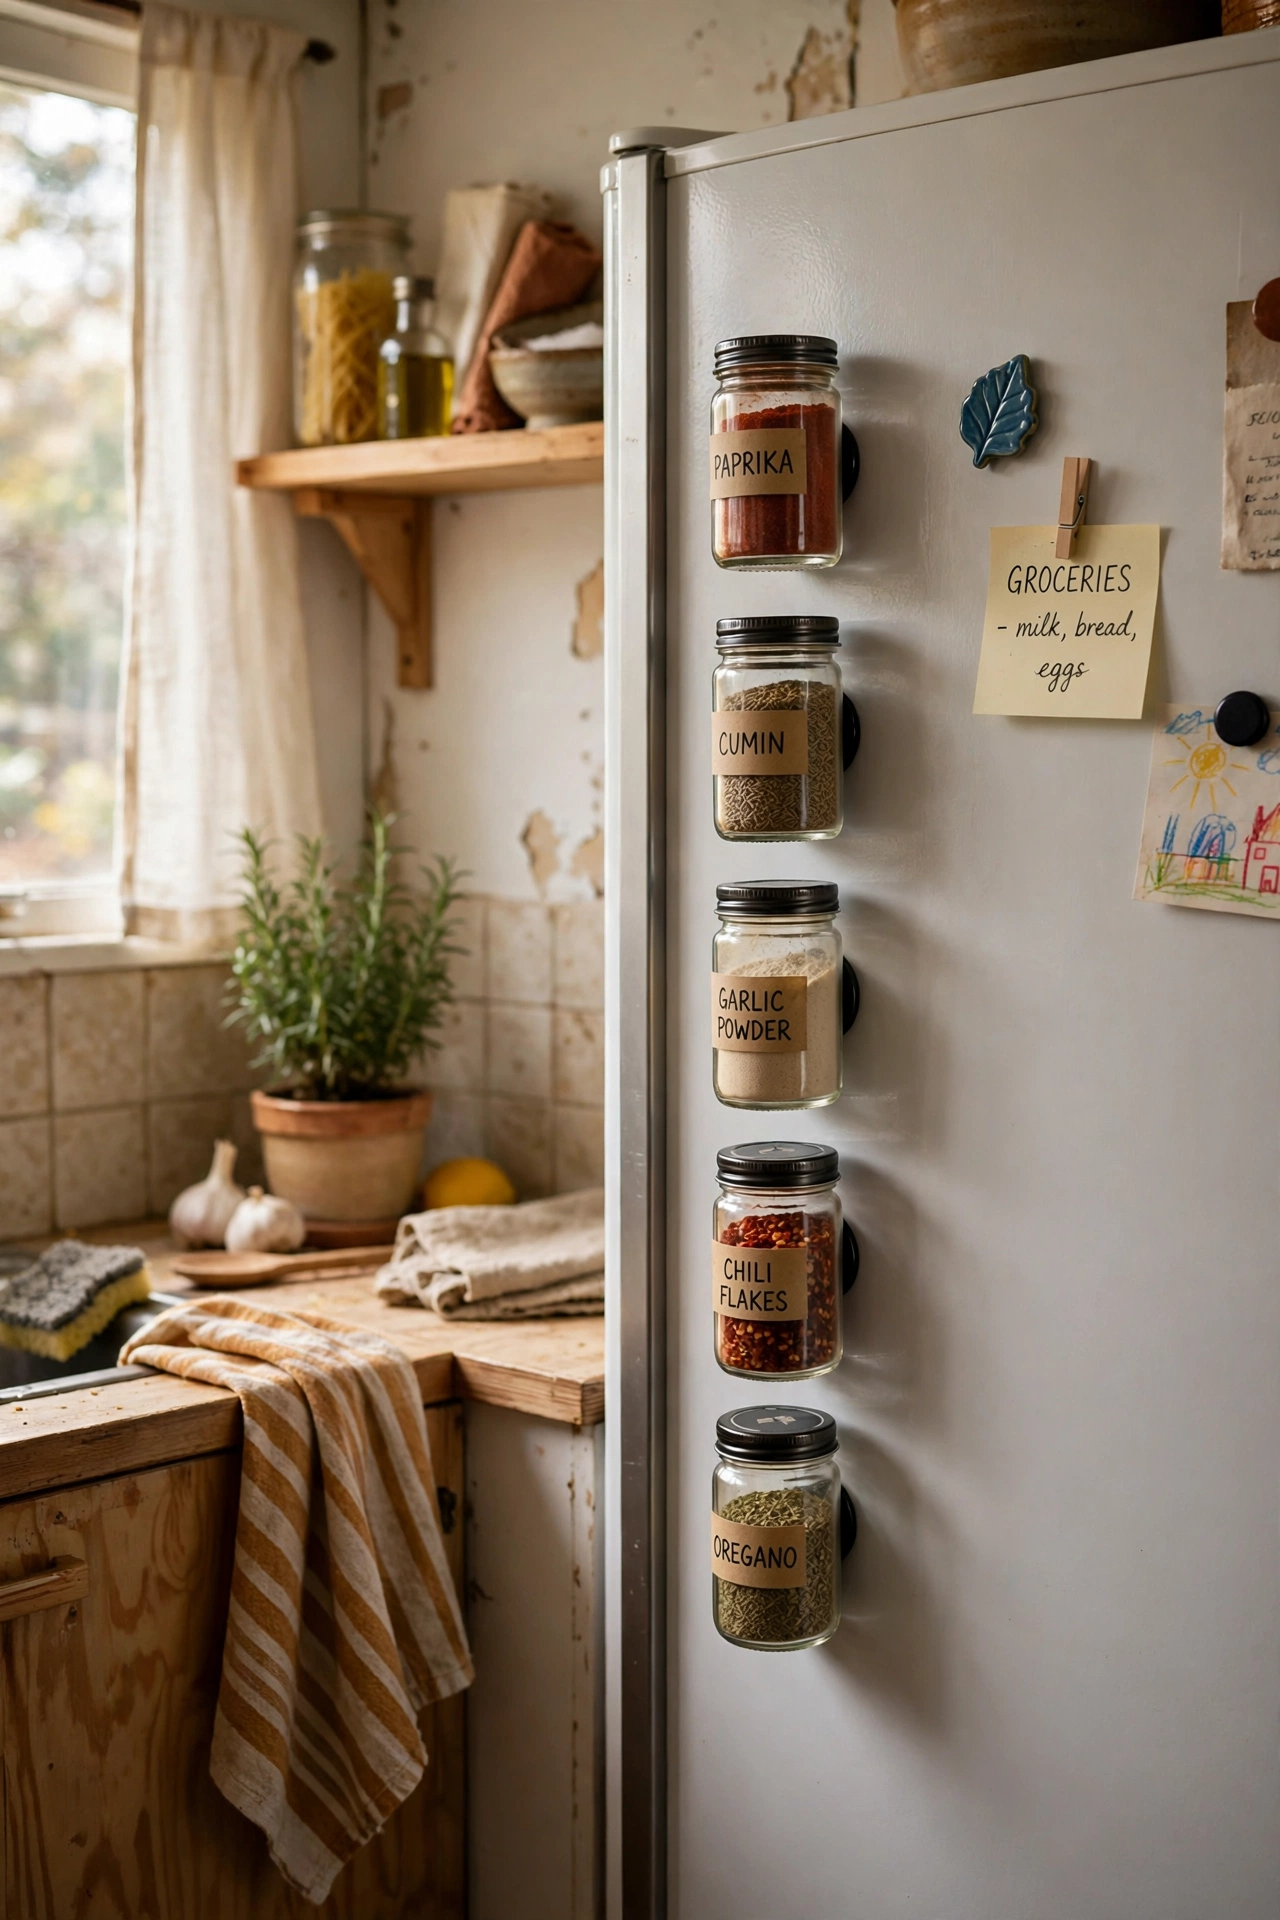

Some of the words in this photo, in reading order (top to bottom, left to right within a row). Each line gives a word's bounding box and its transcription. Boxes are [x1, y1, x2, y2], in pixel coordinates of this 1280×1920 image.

[714, 449, 794, 480] PAPRIKA
[1007, 564, 1132, 595] GROCERIES
[1015, 611, 1066, 642] milk,
[1074, 610, 1137, 642] bread,
[1034, 661, 1090, 692] eggs
[718, 731, 785, 756] CUMIN
[718, 986, 785, 1012] GARLIC
[717, 1016, 792, 1041] POWDER
[723, 1257, 772, 1283] CHILI
[720, 1284, 788, 1312] FLAKES
[713, 1534, 798, 1569] OREGANO
